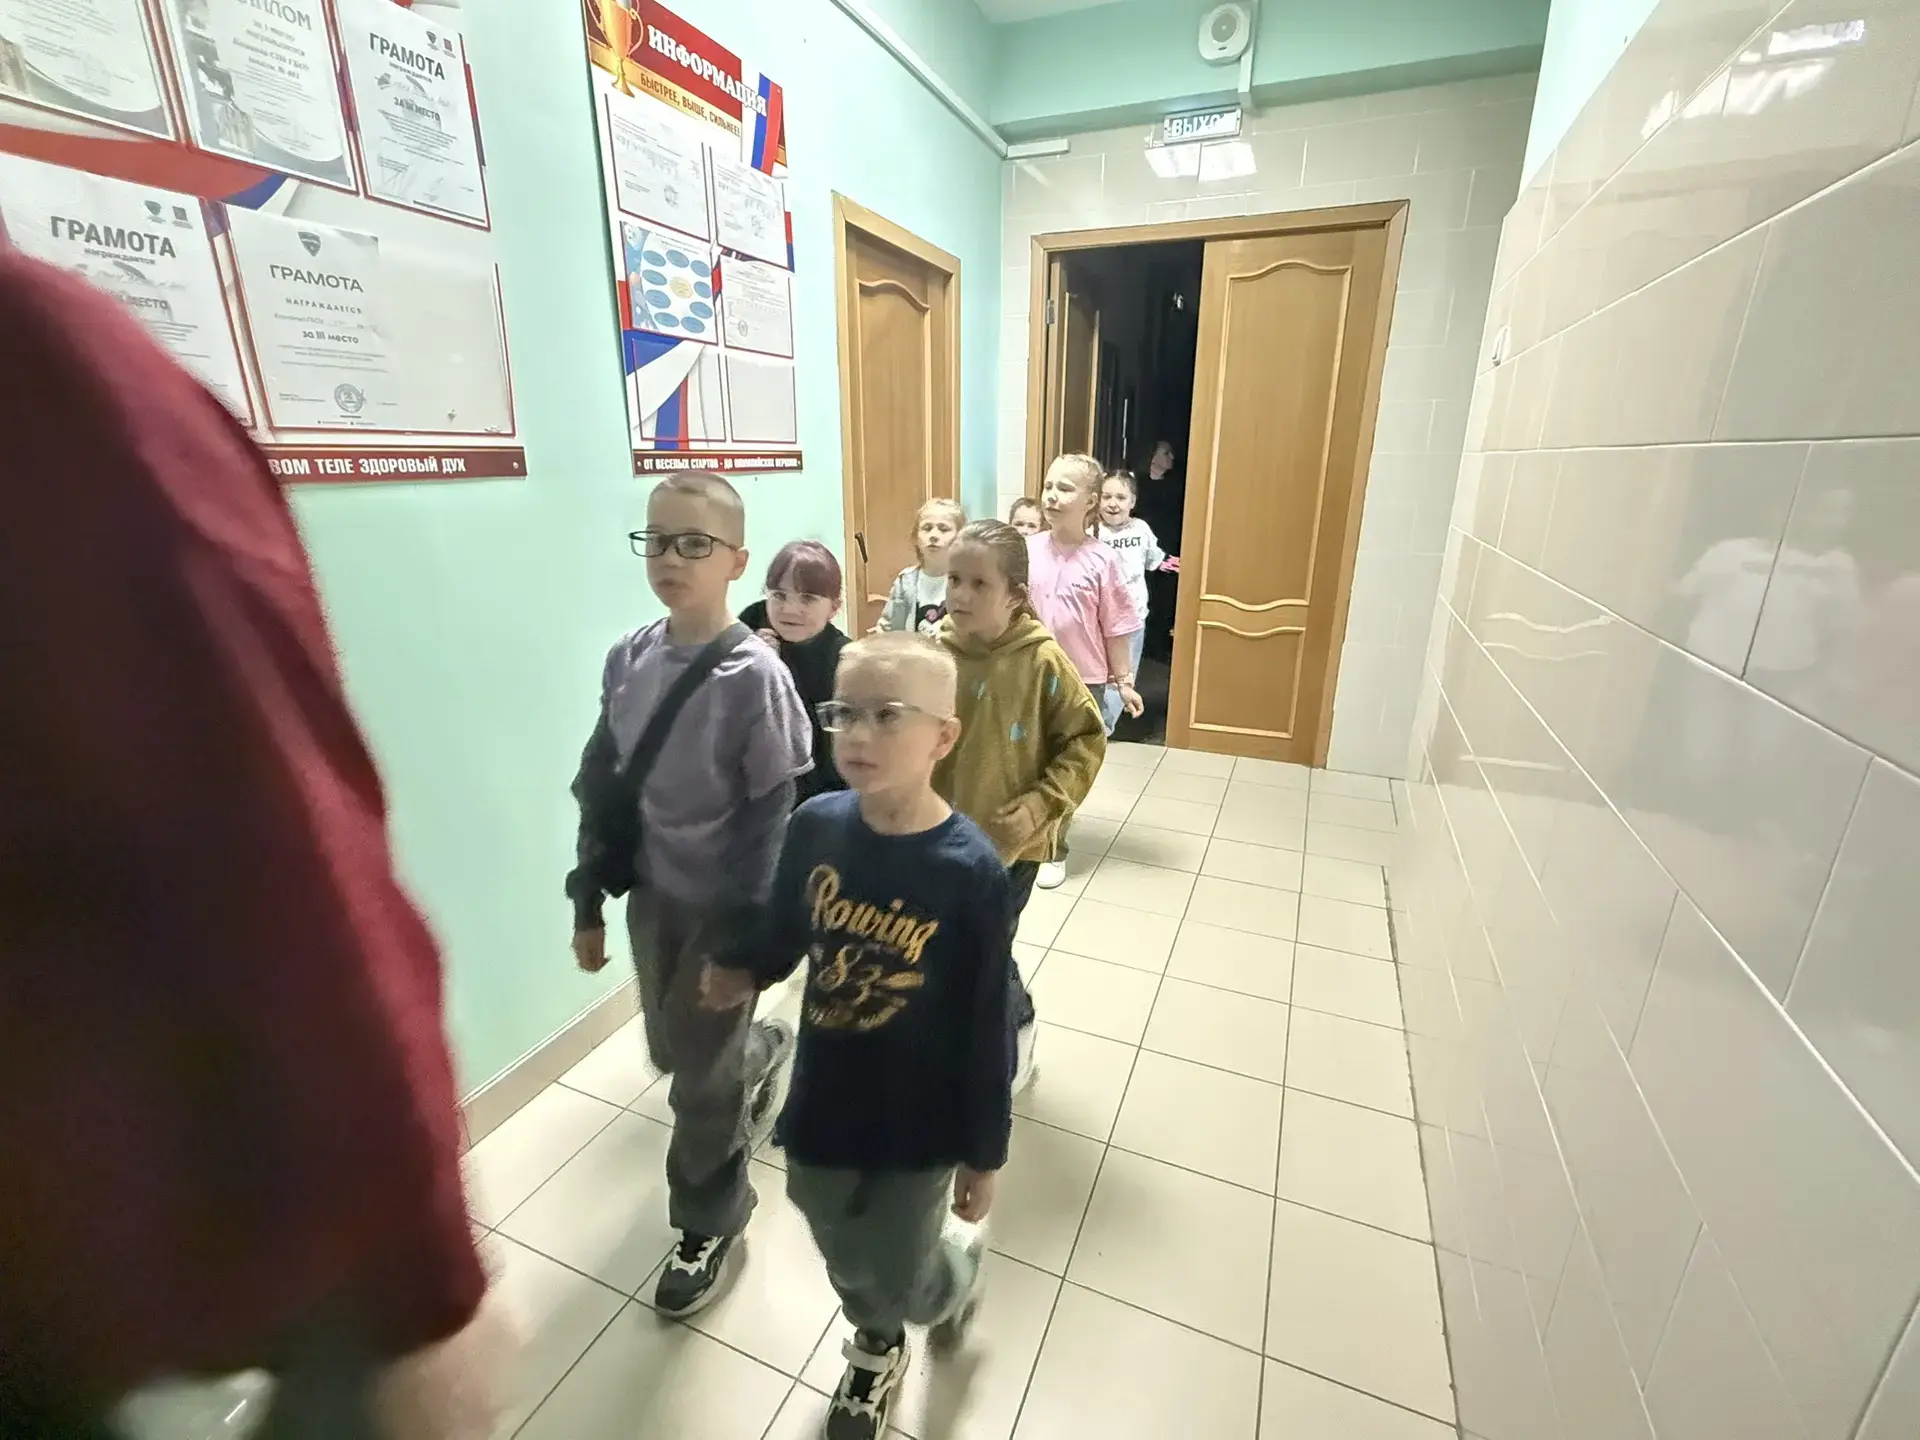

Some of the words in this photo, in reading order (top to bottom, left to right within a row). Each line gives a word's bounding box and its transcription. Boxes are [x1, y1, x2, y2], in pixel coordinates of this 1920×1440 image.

[369, 32, 445, 80] ГРАМОТА
[647, 24, 767, 117] ИНФОРМАЦИЯ
[640, 72, 680, 105] БЫСТРЕЕ,
[682, 96, 708, 120] ВЫШЕ,
[709, 110, 741, 138] СИЛЬНЕЕ!
[1171, 112, 1229, 137] ВЫХО
[50, 215, 176, 259] ГРАМОТА
[269, 264, 364, 293] ГРАМОТА
[286, 297, 362, 315] НАГРАЖДАЕТСЯ
[302, 330, 315, 340] за
[328, 334, 359, 344] место
[267, 458, 311, 475] ВОМ
[314, 458, 355, 474] ТЕЛЕ
[359, 456, 438, 476] ЗДОРОВЫЙ
[441, 458, 466, 475] ДУХ
[643, 458, 654, 470] ОТ
[807, 864, 940, 965] Rowing
